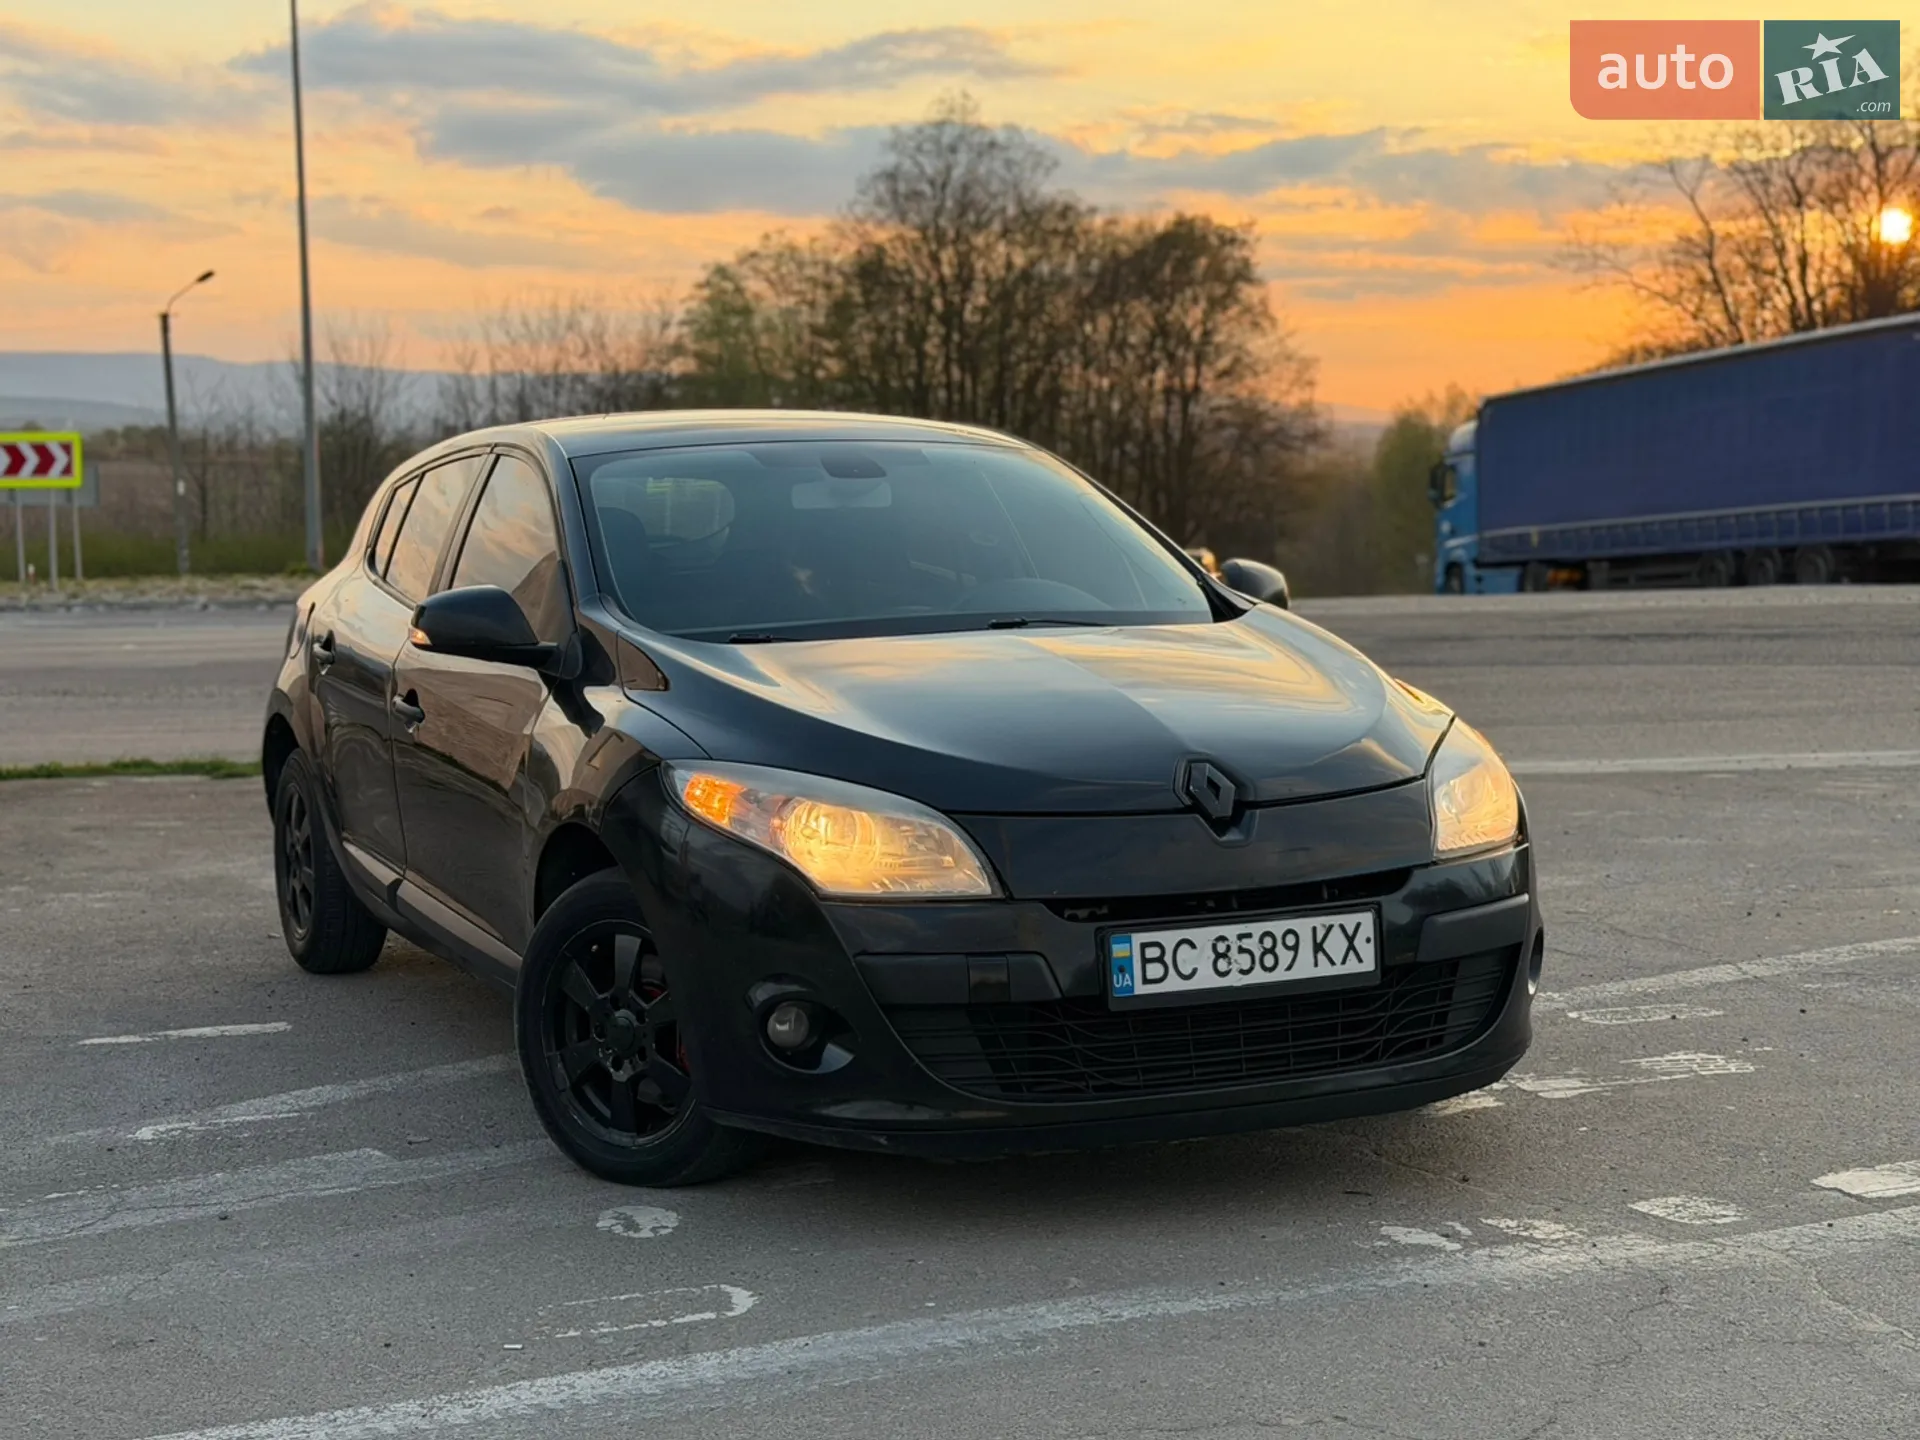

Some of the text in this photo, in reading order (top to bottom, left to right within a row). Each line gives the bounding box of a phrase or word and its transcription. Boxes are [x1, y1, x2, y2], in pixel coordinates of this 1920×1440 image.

[1139, 921, 1364, 985] BC 8589 KX
[1113, 973, 1133, 988] UA
